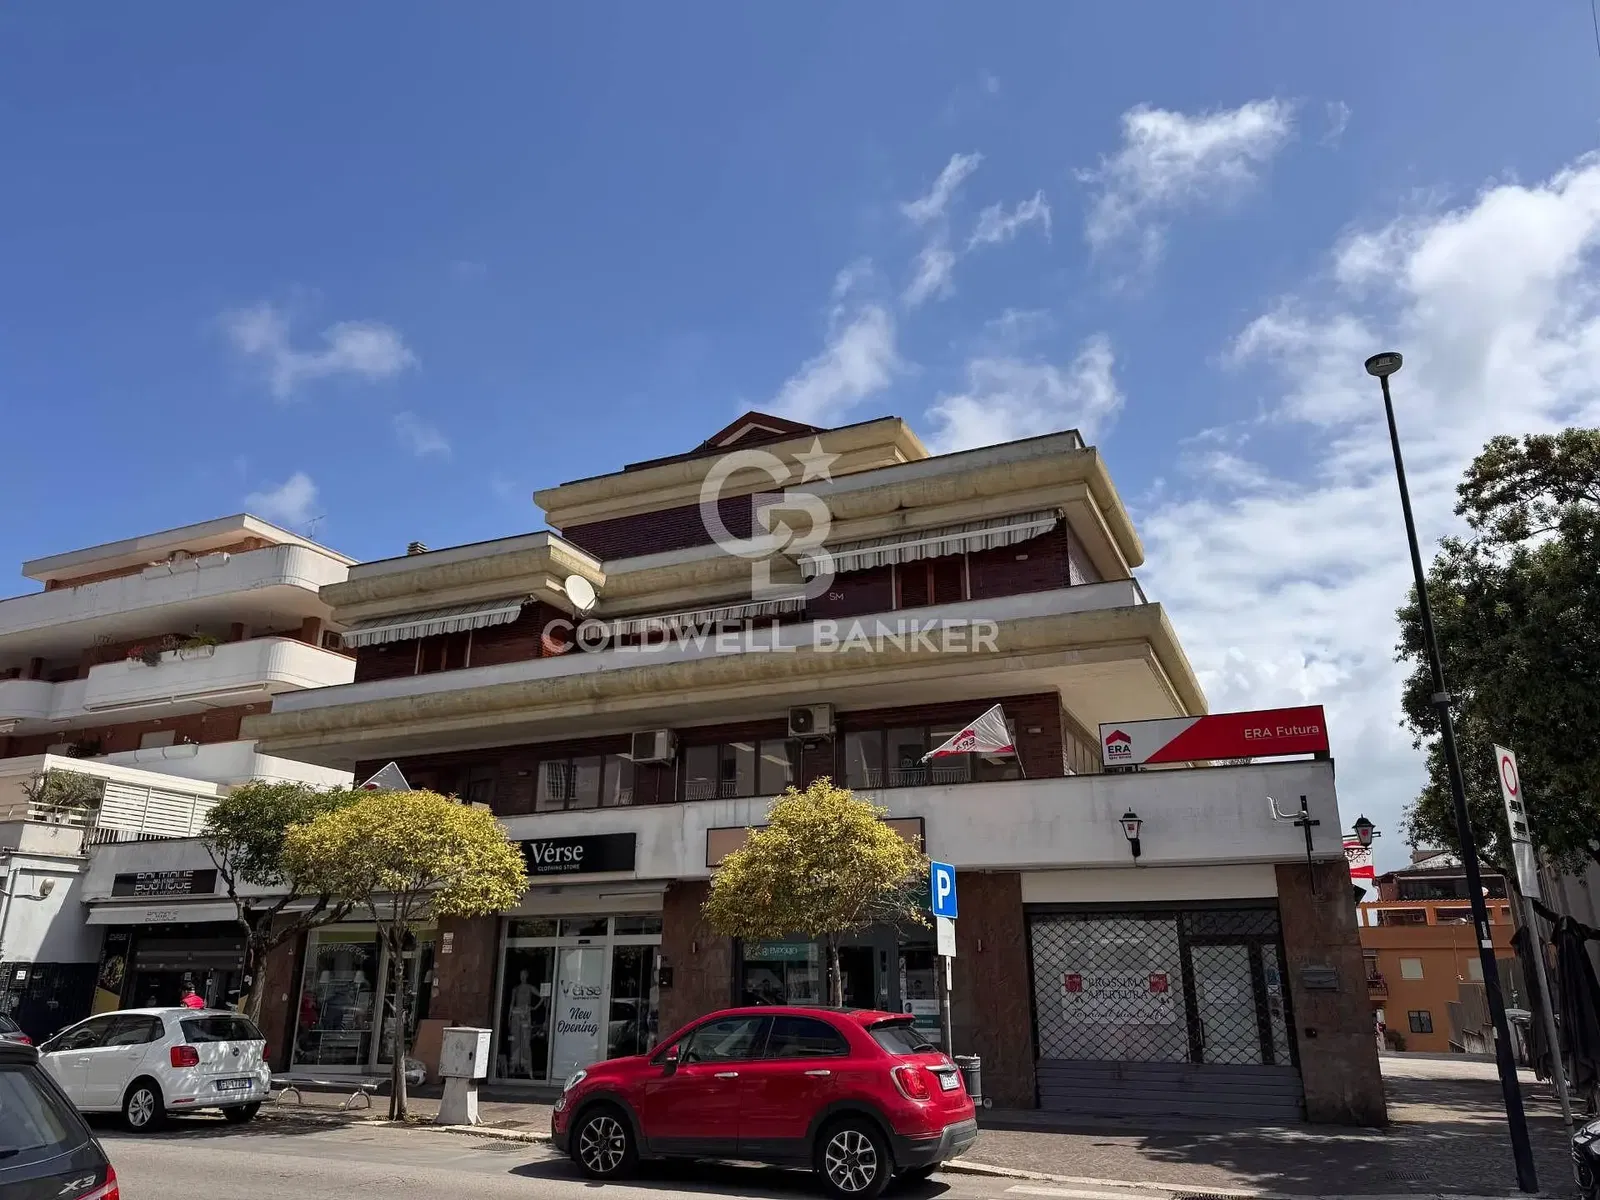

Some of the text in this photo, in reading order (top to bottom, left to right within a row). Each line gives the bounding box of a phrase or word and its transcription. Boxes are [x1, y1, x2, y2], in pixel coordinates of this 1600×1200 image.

[1244, 724, 1319, 740] ERA Futura
[1108, 745, 1130, 753] ERA
[530, 842, 584, 864] Vérse
[937, 869, 951, 910] P
[569, 1007, 592, 1020] New
[557, 1020, 599, 1037] Opening
[58, 1174, 97, 1195] X3
